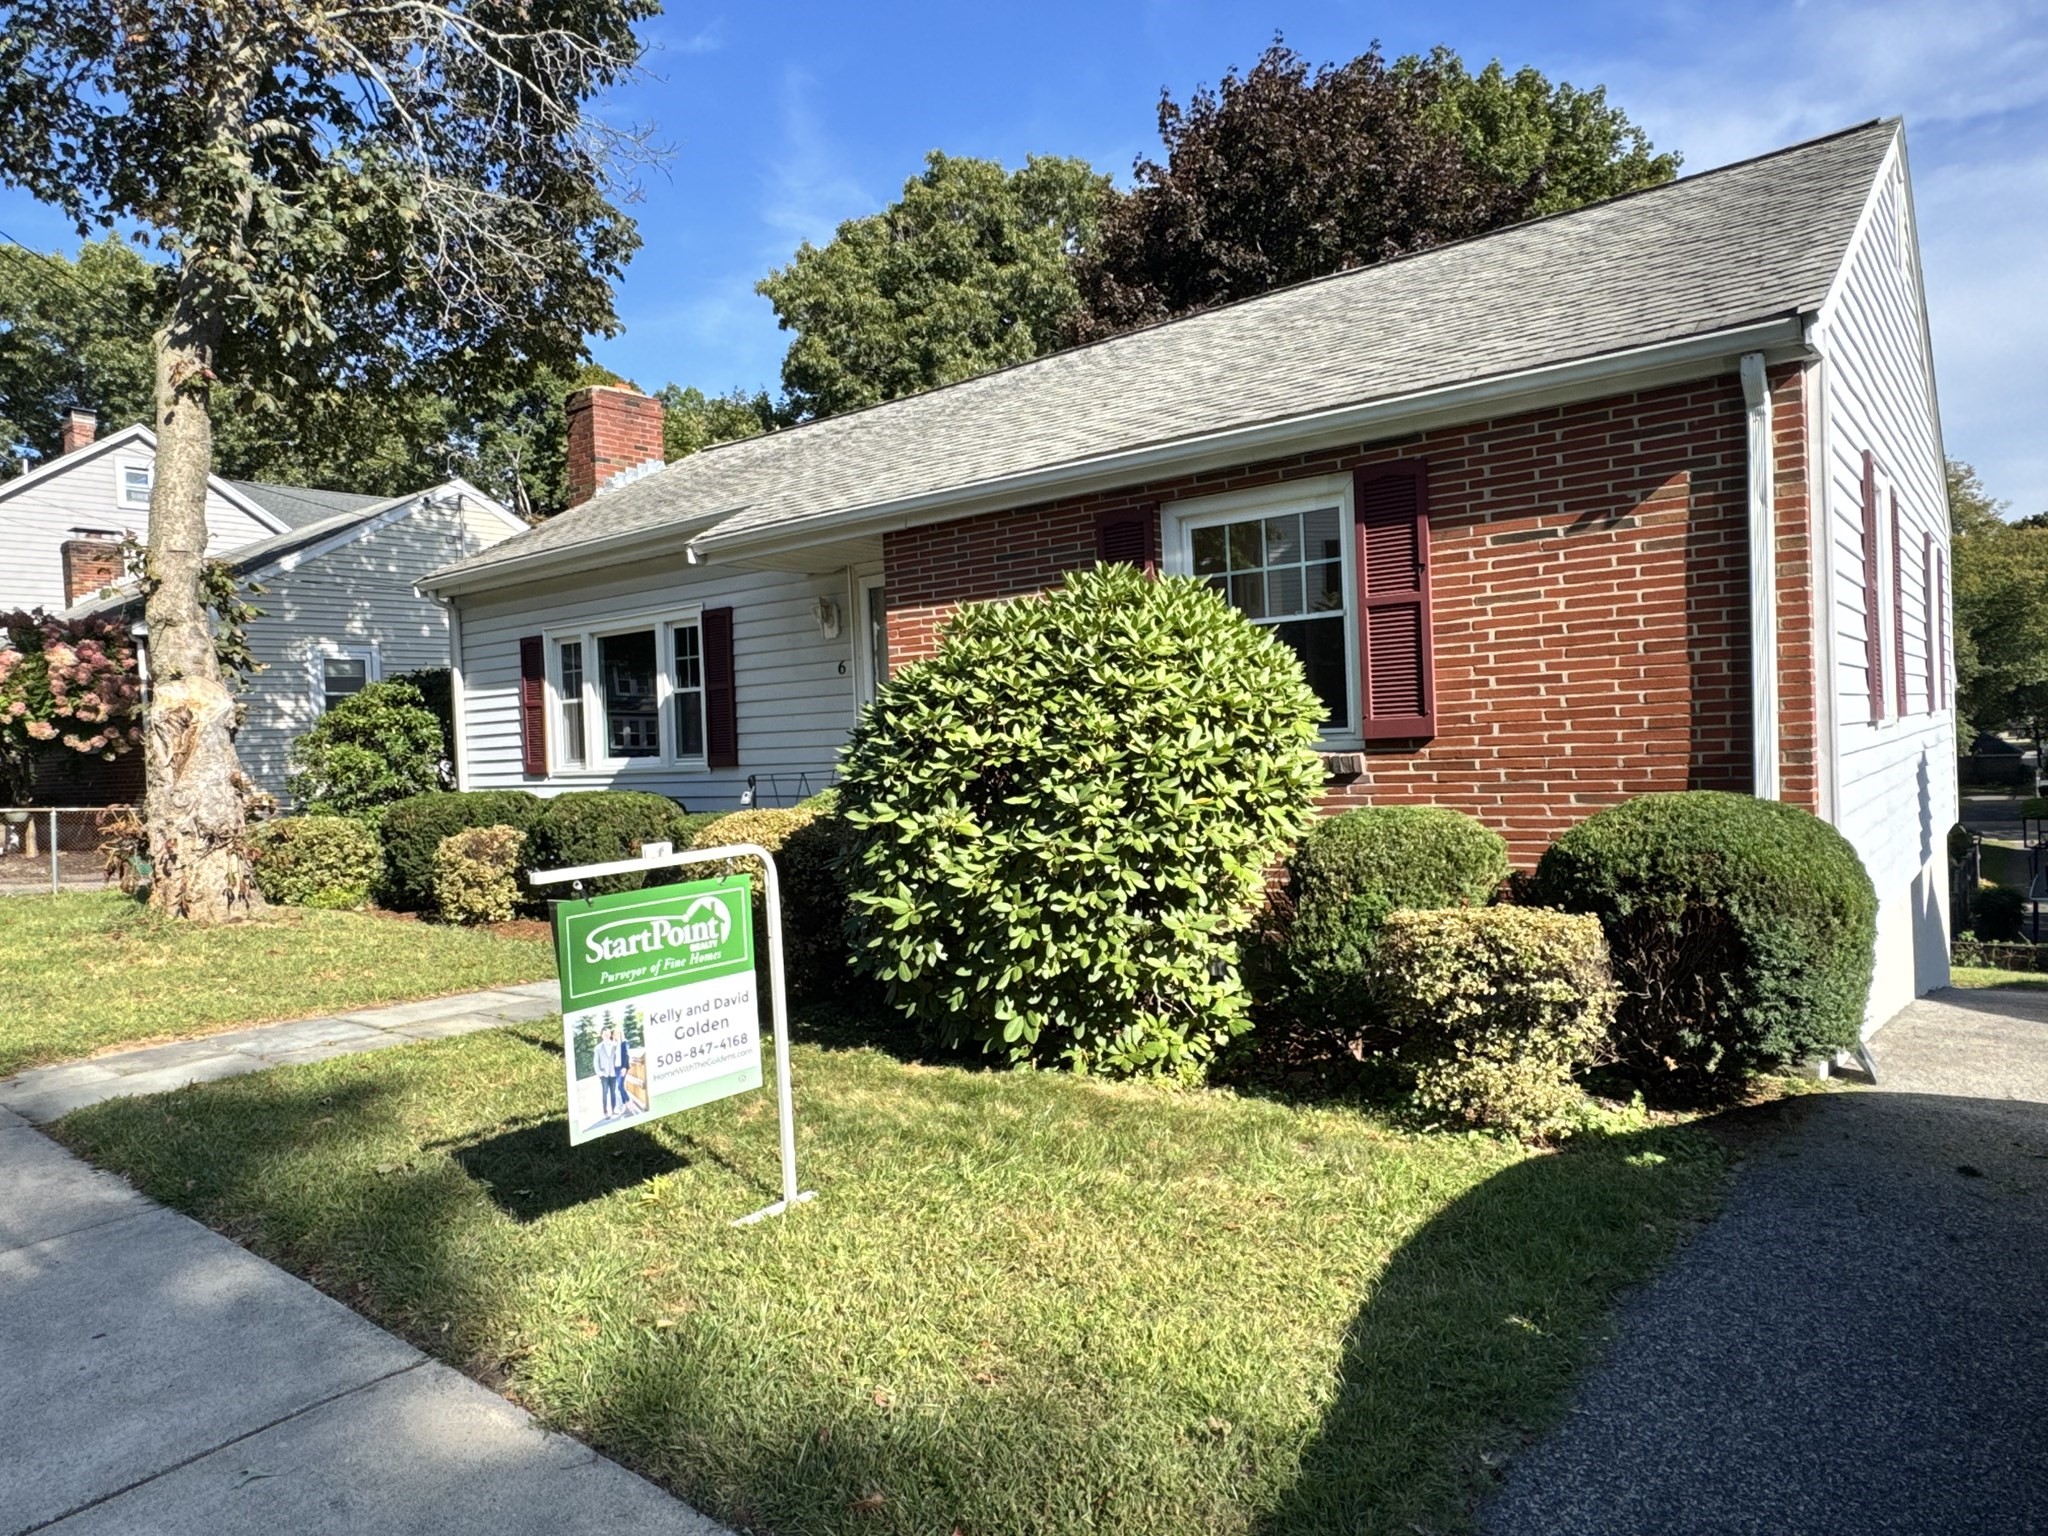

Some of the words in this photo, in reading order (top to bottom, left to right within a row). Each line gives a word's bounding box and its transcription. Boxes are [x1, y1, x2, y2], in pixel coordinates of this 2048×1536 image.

[838, 660, 846, 675] 6
[585, 915, 720, 964] StartPoint
[600, 966, 647, 985] Purveyor
[649, 959, 663, 977] of
[663, 957, 687, 970] Fine
[689, 951, 722, 965] Homes
[650, 1008, 682, 1026] Kelly
[686, 1000, 710, 1016] and
[714, 990, 749, 1010] David
[674, 1017, 729, 1040] Golden
[657, 1033, 748, 1068] 508-847-4168
